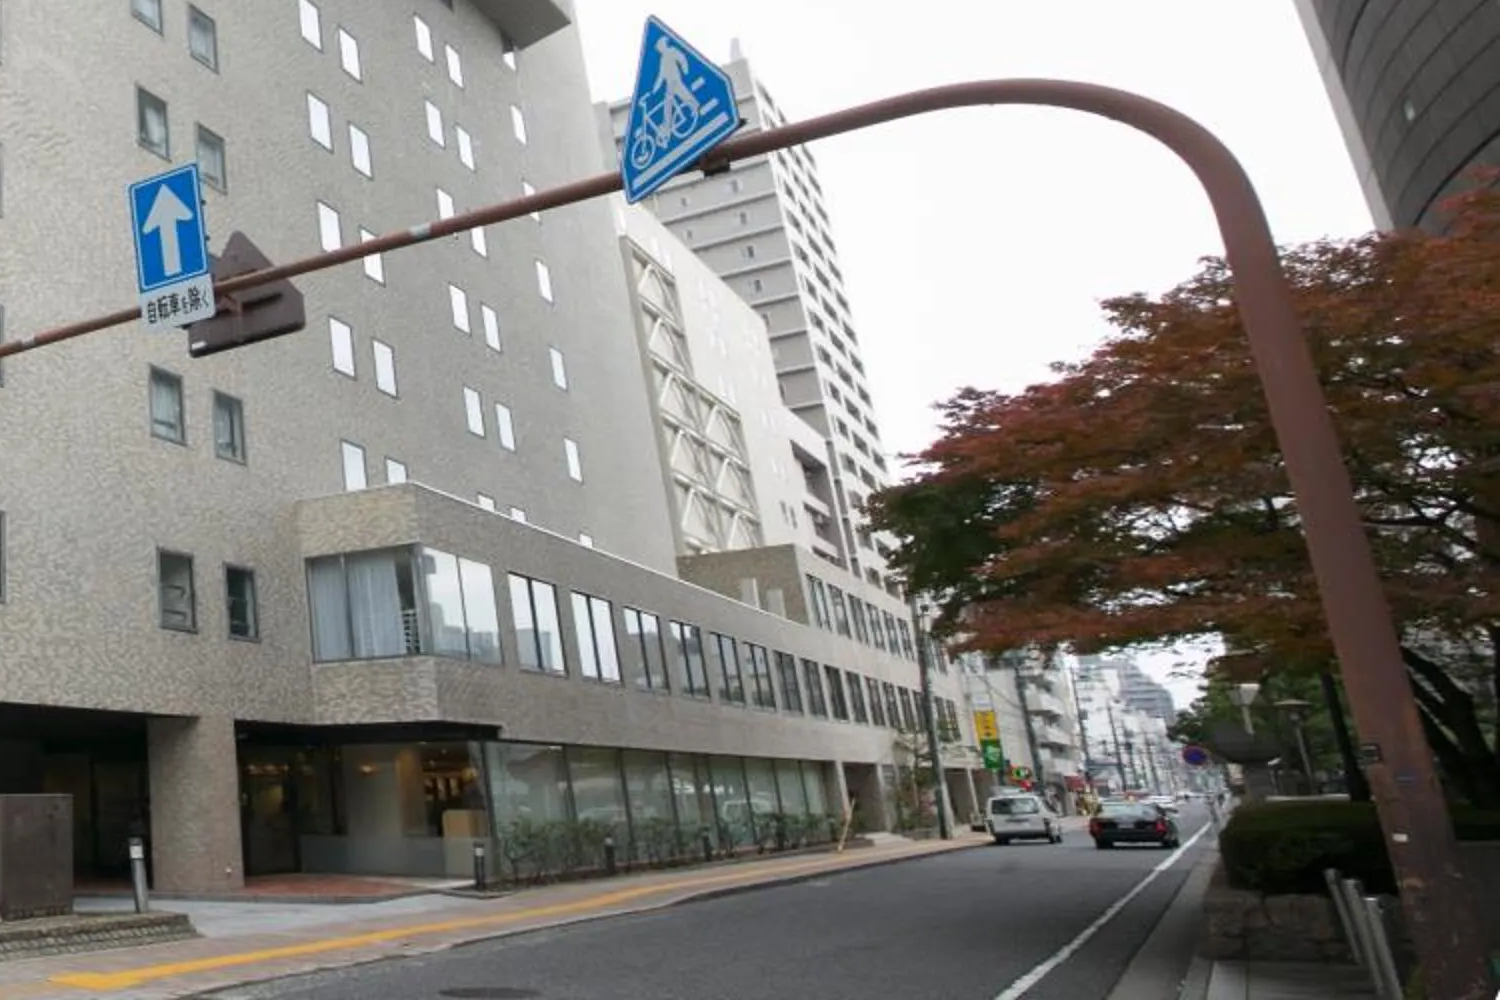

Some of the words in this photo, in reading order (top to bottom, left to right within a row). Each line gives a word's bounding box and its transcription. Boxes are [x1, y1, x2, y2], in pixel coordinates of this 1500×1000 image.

[147, 286, 210, 323] 自転車を除く
